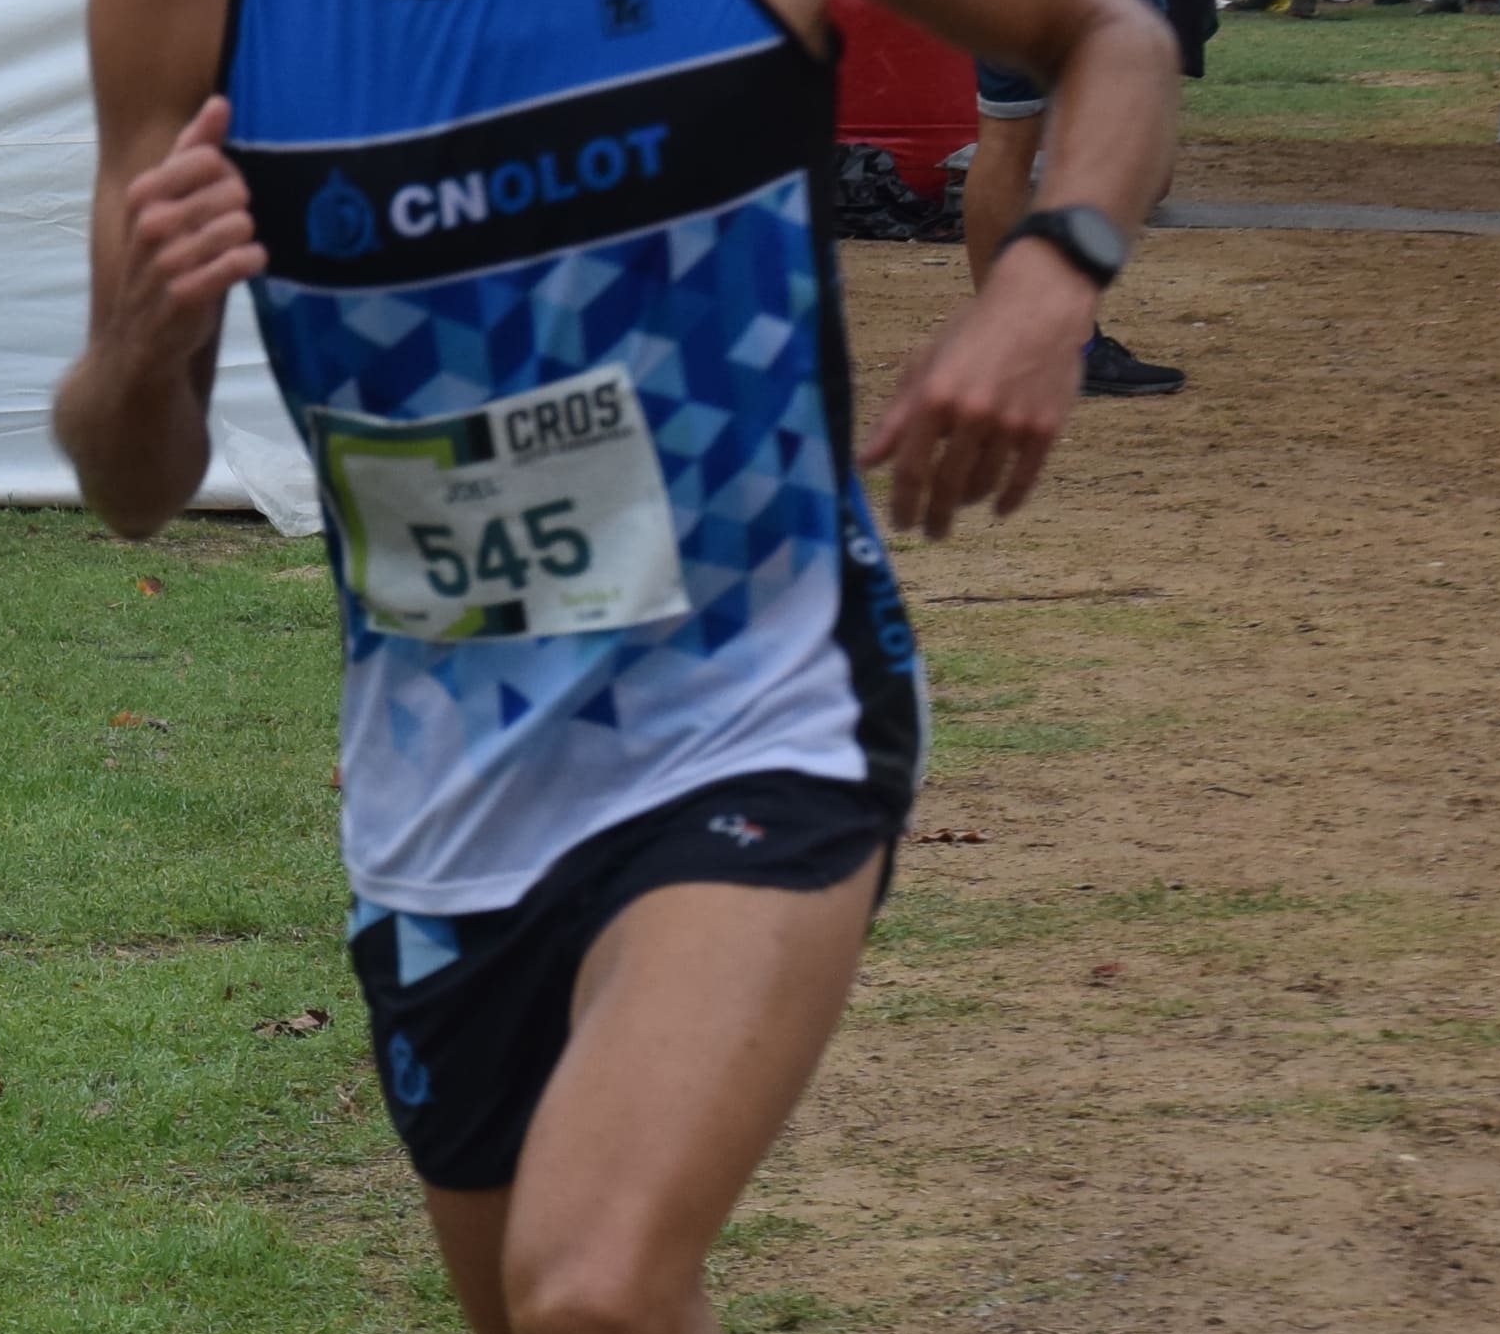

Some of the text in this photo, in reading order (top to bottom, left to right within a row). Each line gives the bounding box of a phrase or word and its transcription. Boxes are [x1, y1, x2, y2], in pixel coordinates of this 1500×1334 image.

[389, 123, 669, 238] CNOLOT
[504, 378, 622, 453] CROS
[408, 498, 592, 599] 545
